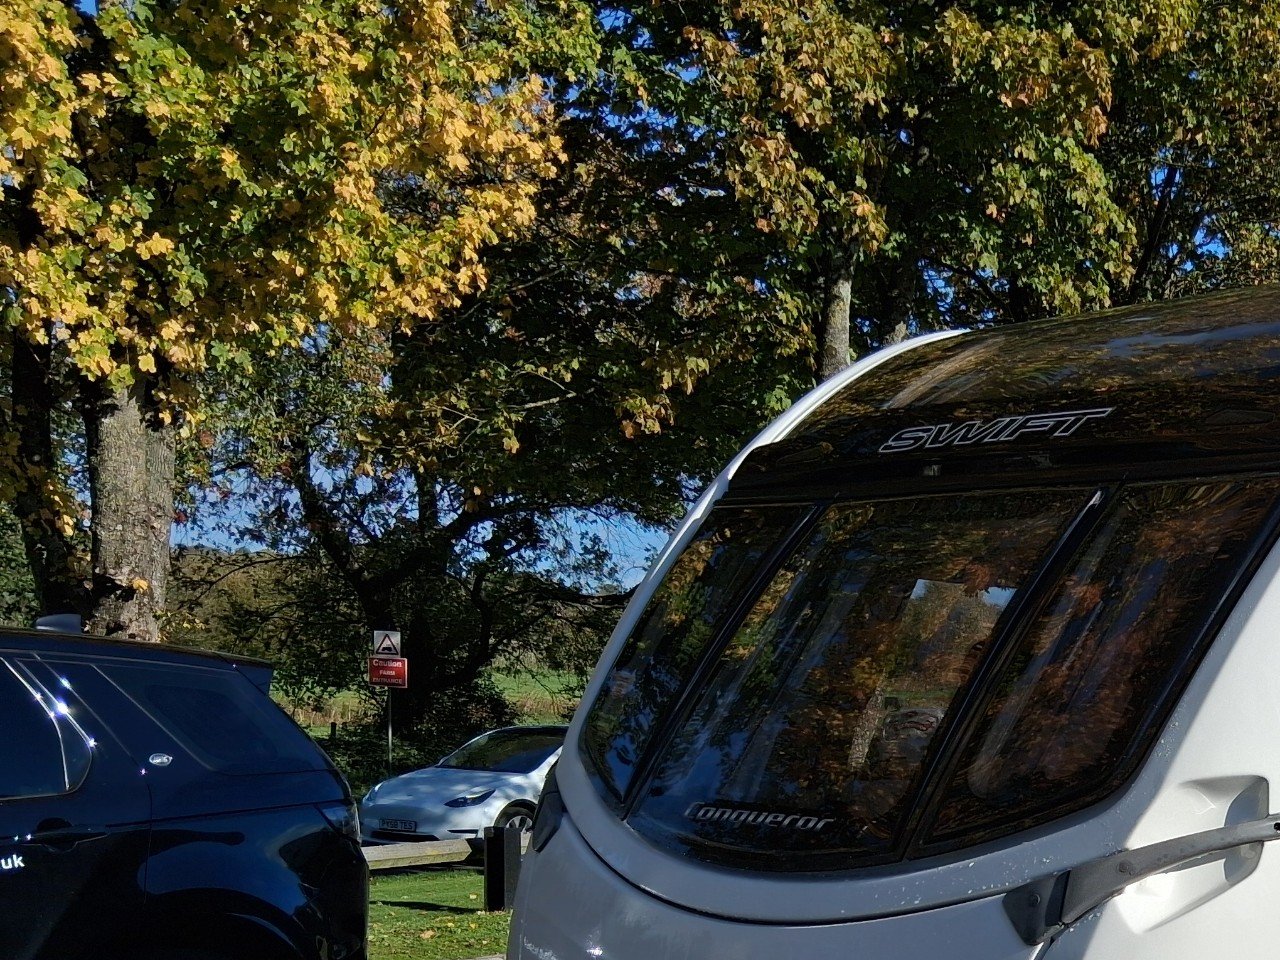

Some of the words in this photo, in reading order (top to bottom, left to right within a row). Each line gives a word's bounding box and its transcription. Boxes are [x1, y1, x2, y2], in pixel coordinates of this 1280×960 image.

[879, 407, 1116, 452] SWIFT
[372, 659, 402, 668] Caution
[684, 801, 836, 831] Conqueror
